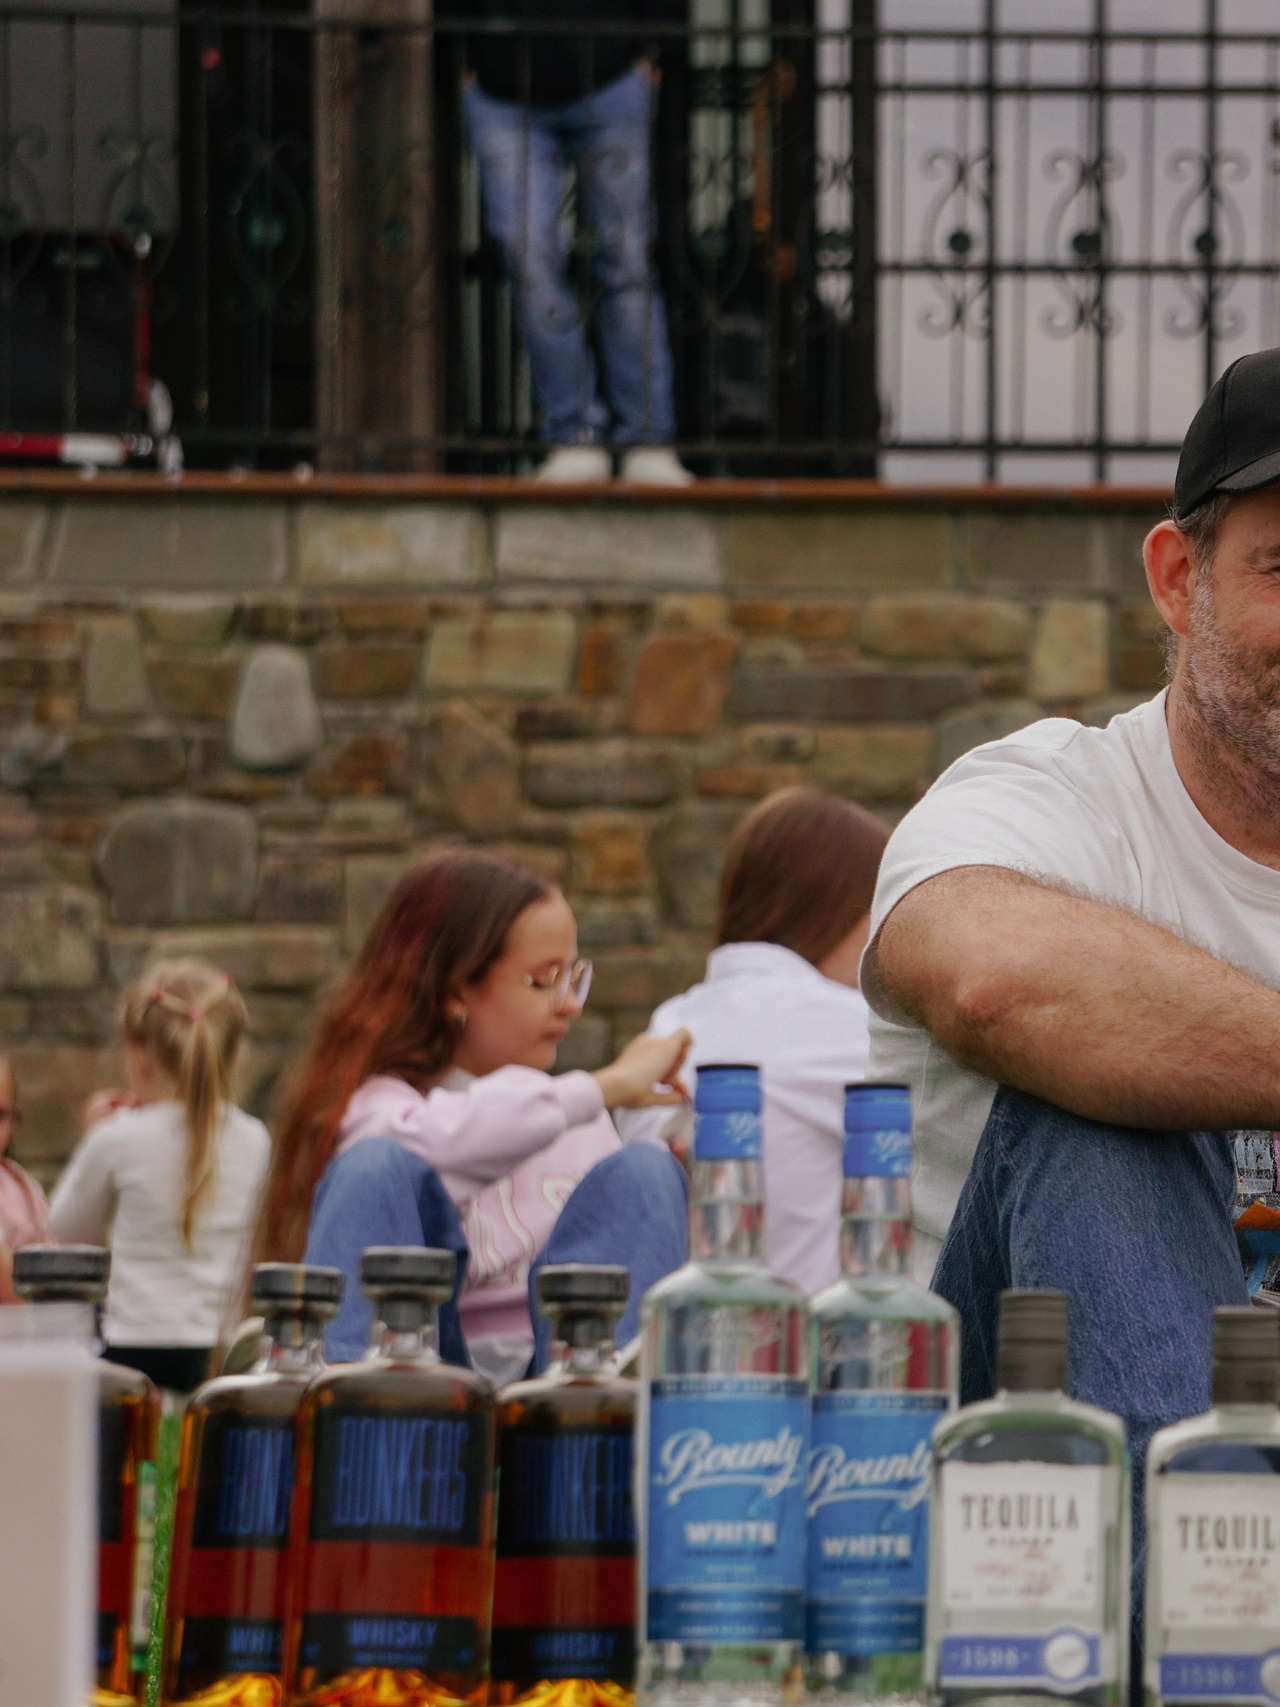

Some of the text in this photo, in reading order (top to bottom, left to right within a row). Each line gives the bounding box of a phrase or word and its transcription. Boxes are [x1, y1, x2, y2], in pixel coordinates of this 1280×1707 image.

[216, 1427, 294, 1537] BON
[333, 1416, 470, 1532] BONKERS
[657, 1423, 804, 1506] Bounty
[806, 1439, 935, 1517] Bounty
[960, 1493, 1080, 1530] TEQUILA
[684, 1520, 778, 1545] WHITE
[821, 1534, 914, 1560] WHITE
[347, 1618, 438, 1649] WHISKY
[533, 1632, 618, 1660] WHISKY
